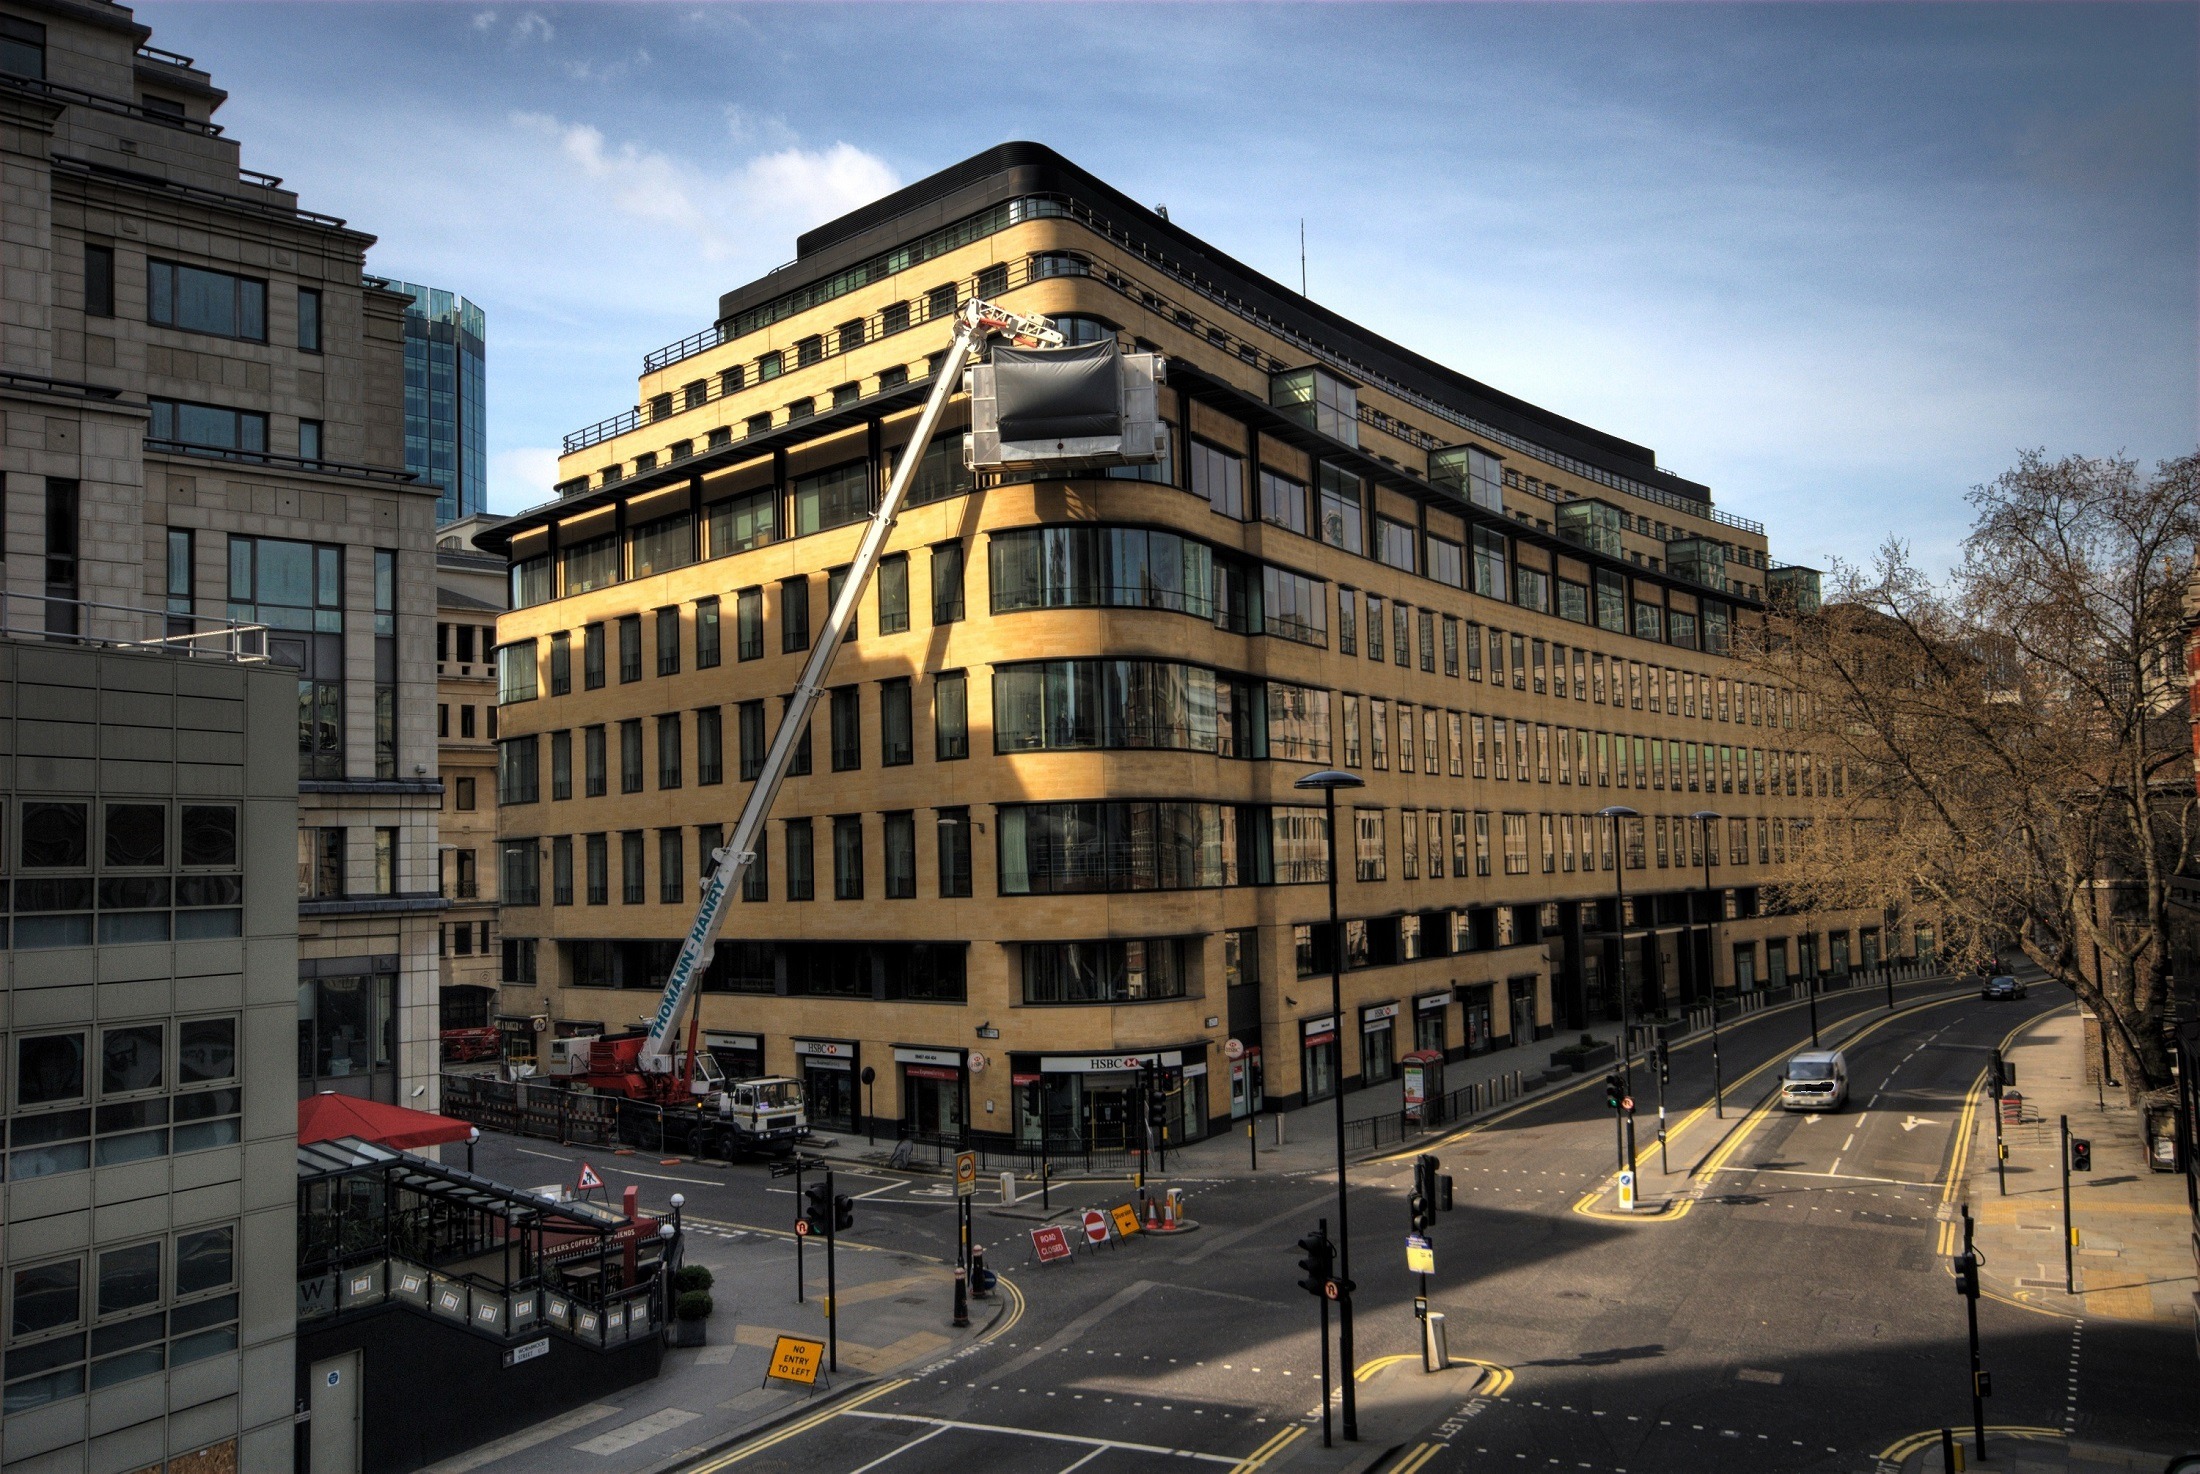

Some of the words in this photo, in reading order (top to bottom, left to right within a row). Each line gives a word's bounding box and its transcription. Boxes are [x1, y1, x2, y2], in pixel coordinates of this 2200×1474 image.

[650, 950, 695, 1040] THOMANN
[692, 875, 725, 943] HANRY
[808, 1042, 826, 1053] HSBC
[1091, 1059, 1122, 1069] HSBC
[1040, 1233, 1056, 1243] ROAD
[1041, 1244, 1064, 1255] CLOSED
[518, 1341, 546, 1354] WORMWOOD
[793, 1345, 805, 1354] NO
[517, 1351, 533, 1360] STREET
[784, 1355, 809, 1364] ENTRY
[778, 1365, 789, 1373] TO
[791, 1367, 810, 1376] LEFT
